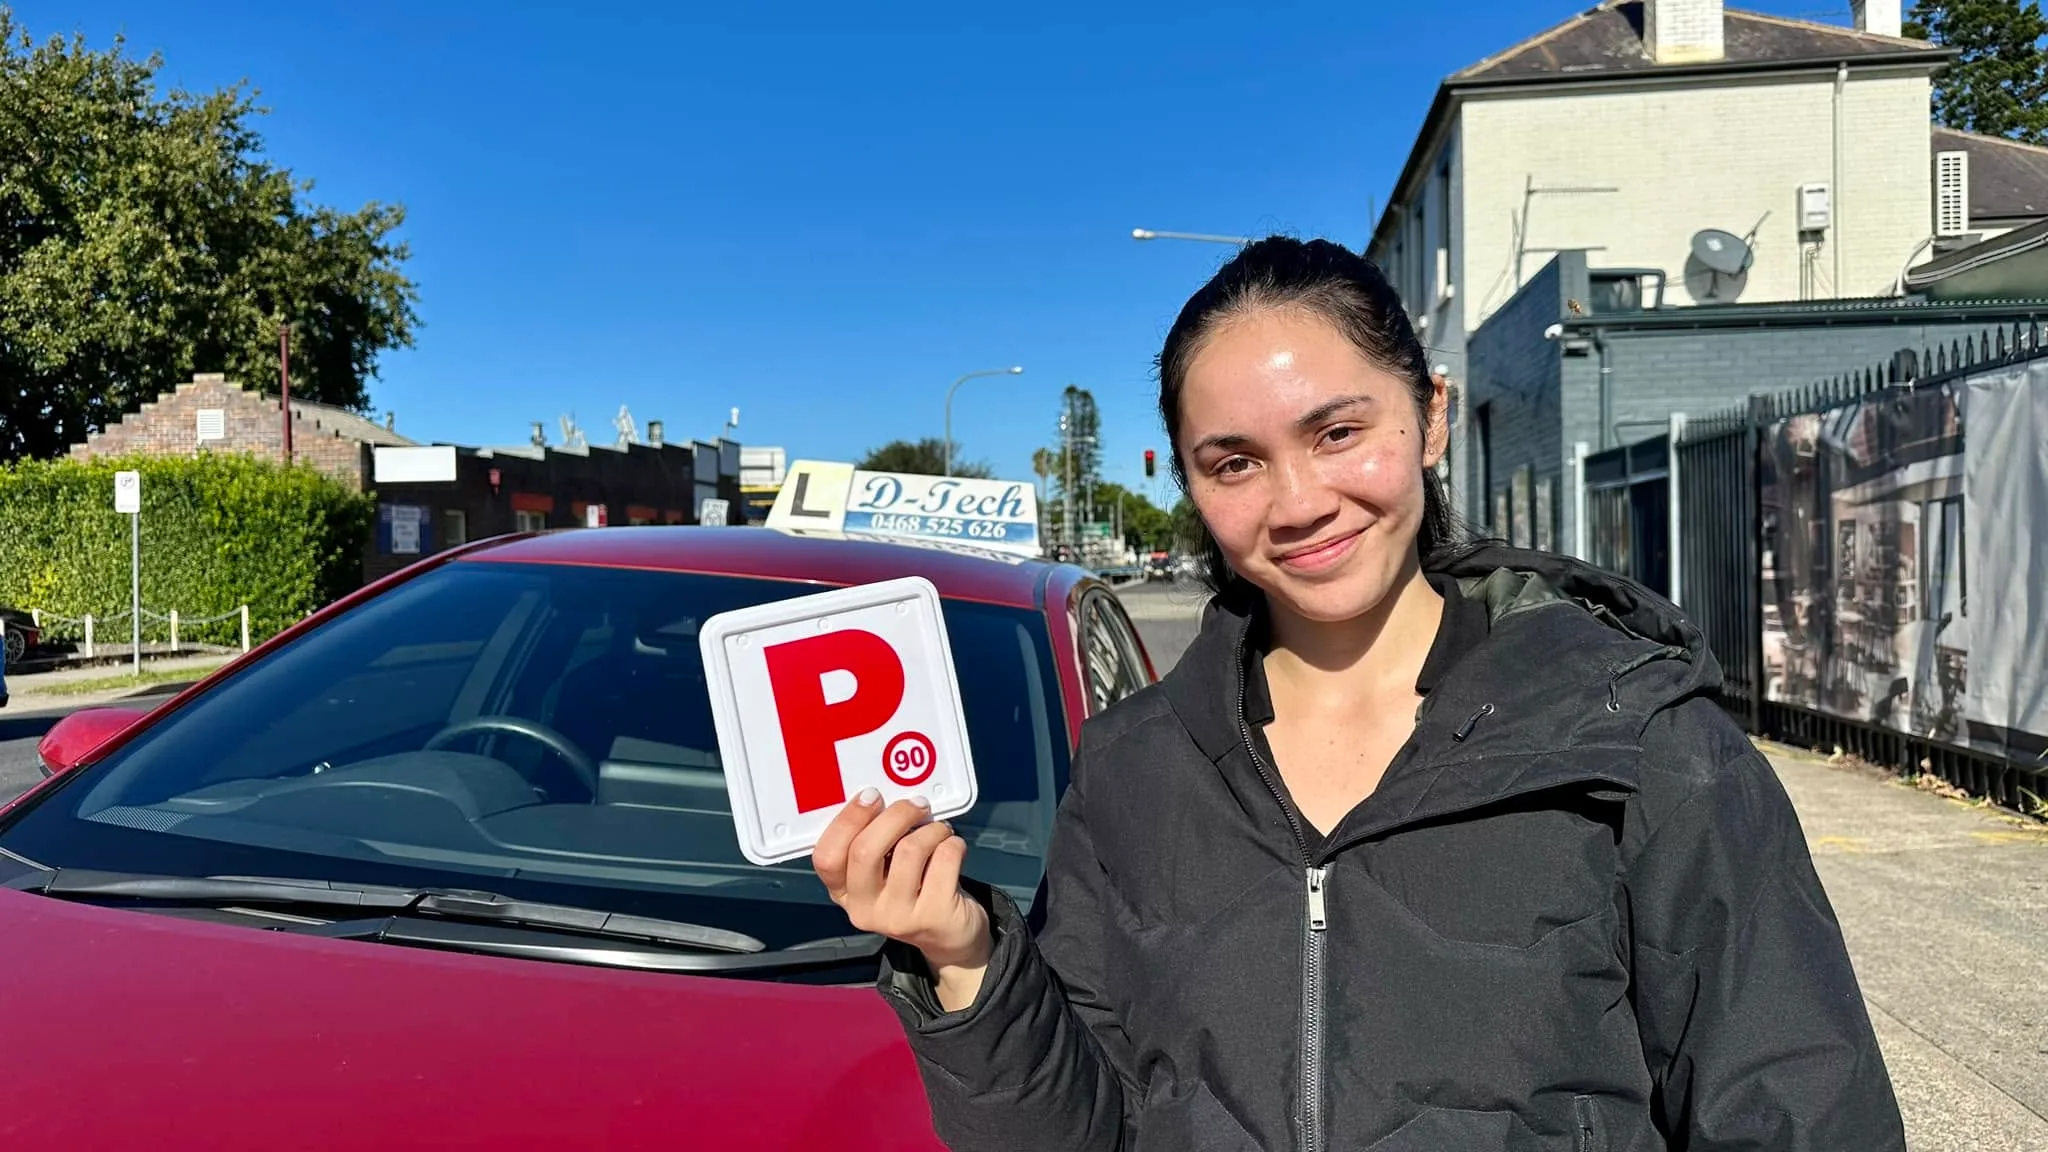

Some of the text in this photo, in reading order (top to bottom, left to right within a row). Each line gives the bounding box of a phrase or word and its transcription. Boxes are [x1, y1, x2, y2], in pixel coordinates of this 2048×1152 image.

[790, 472, 831, 519] L
[859, 475, 1026, 518] D-Tech
[871, 513, 1007, 538] 0468 525 626
[763, 628, 905, 814] P
[894, 746, 925, 771] 90
